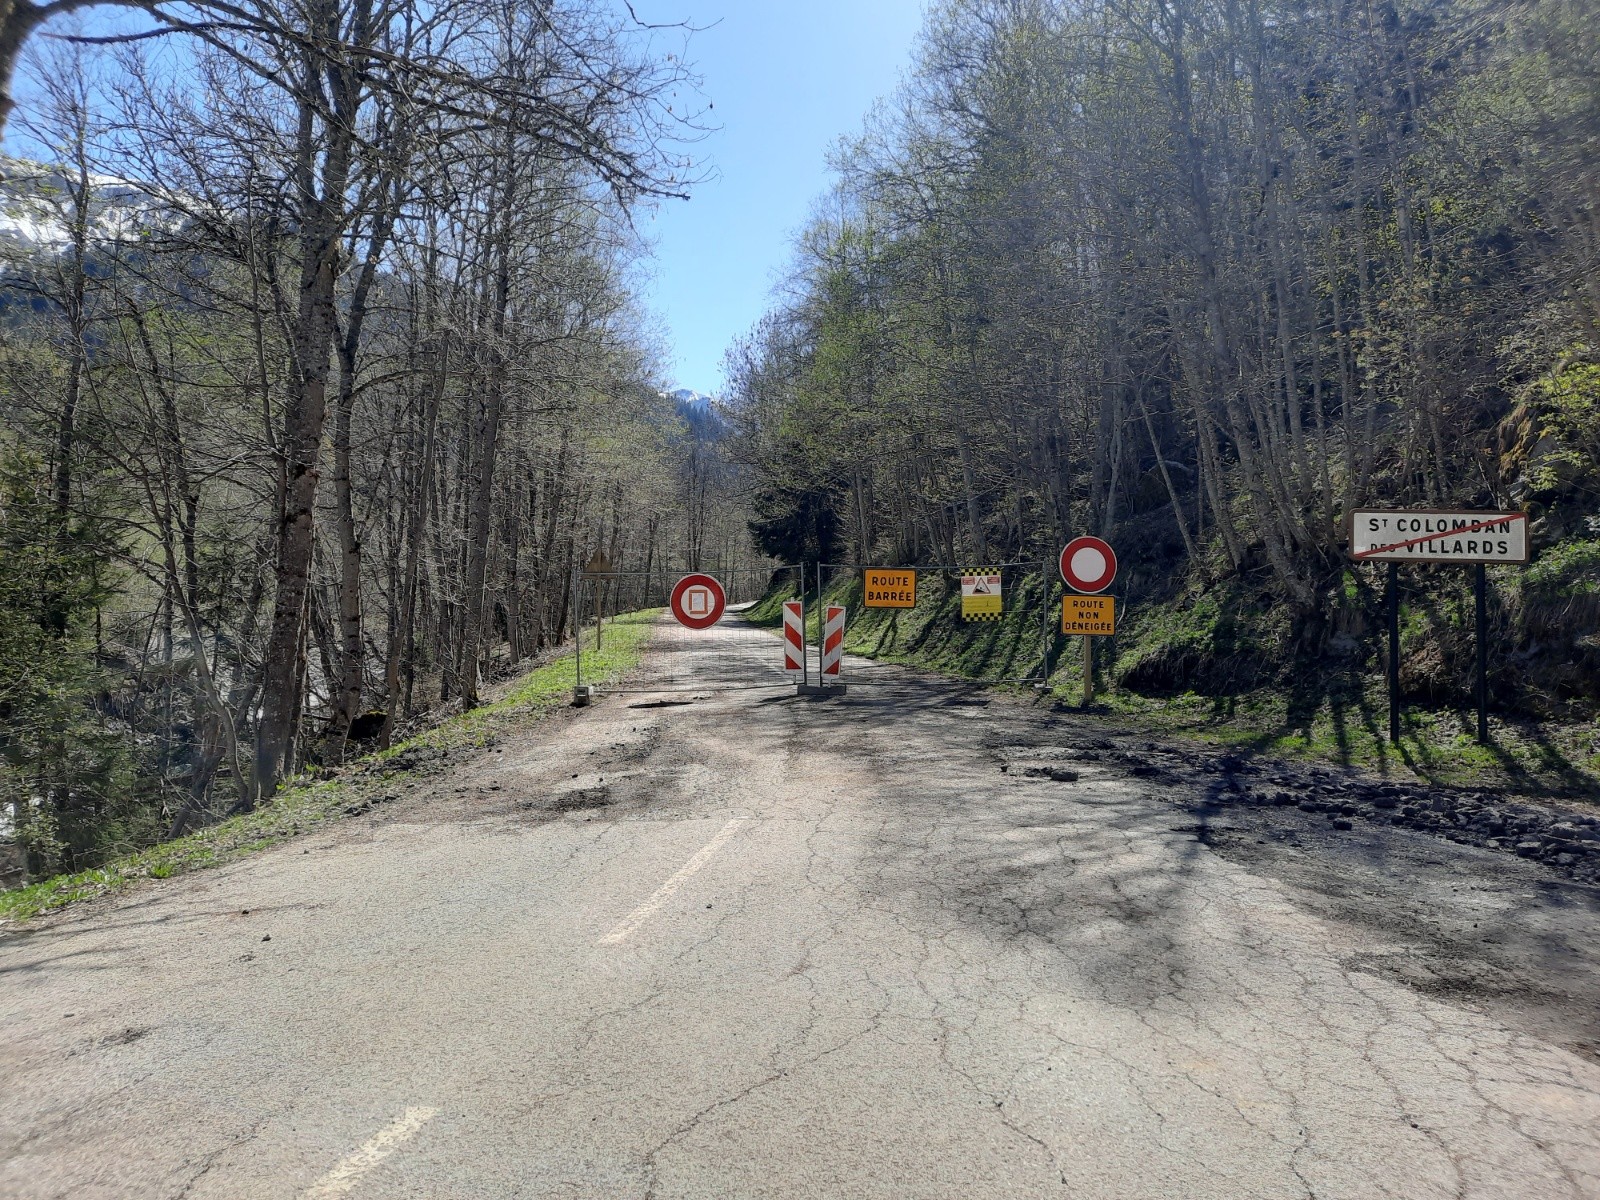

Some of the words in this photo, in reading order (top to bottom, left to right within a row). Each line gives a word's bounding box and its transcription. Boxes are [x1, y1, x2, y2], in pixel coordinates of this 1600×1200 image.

[1397, 518, 1510, 534] COLOMBAN
[1405, 539, 1508, 554] VILLARDS
[871, 576, 909, 587] ROUTE
[867, 589, 912, 602] BARRÉE
[1072, 599, 1105, 609] ROUTE
[1078, 611, 1099, 619] NON
[1065, 620, 1112, 632] DÉNEIGÉE
